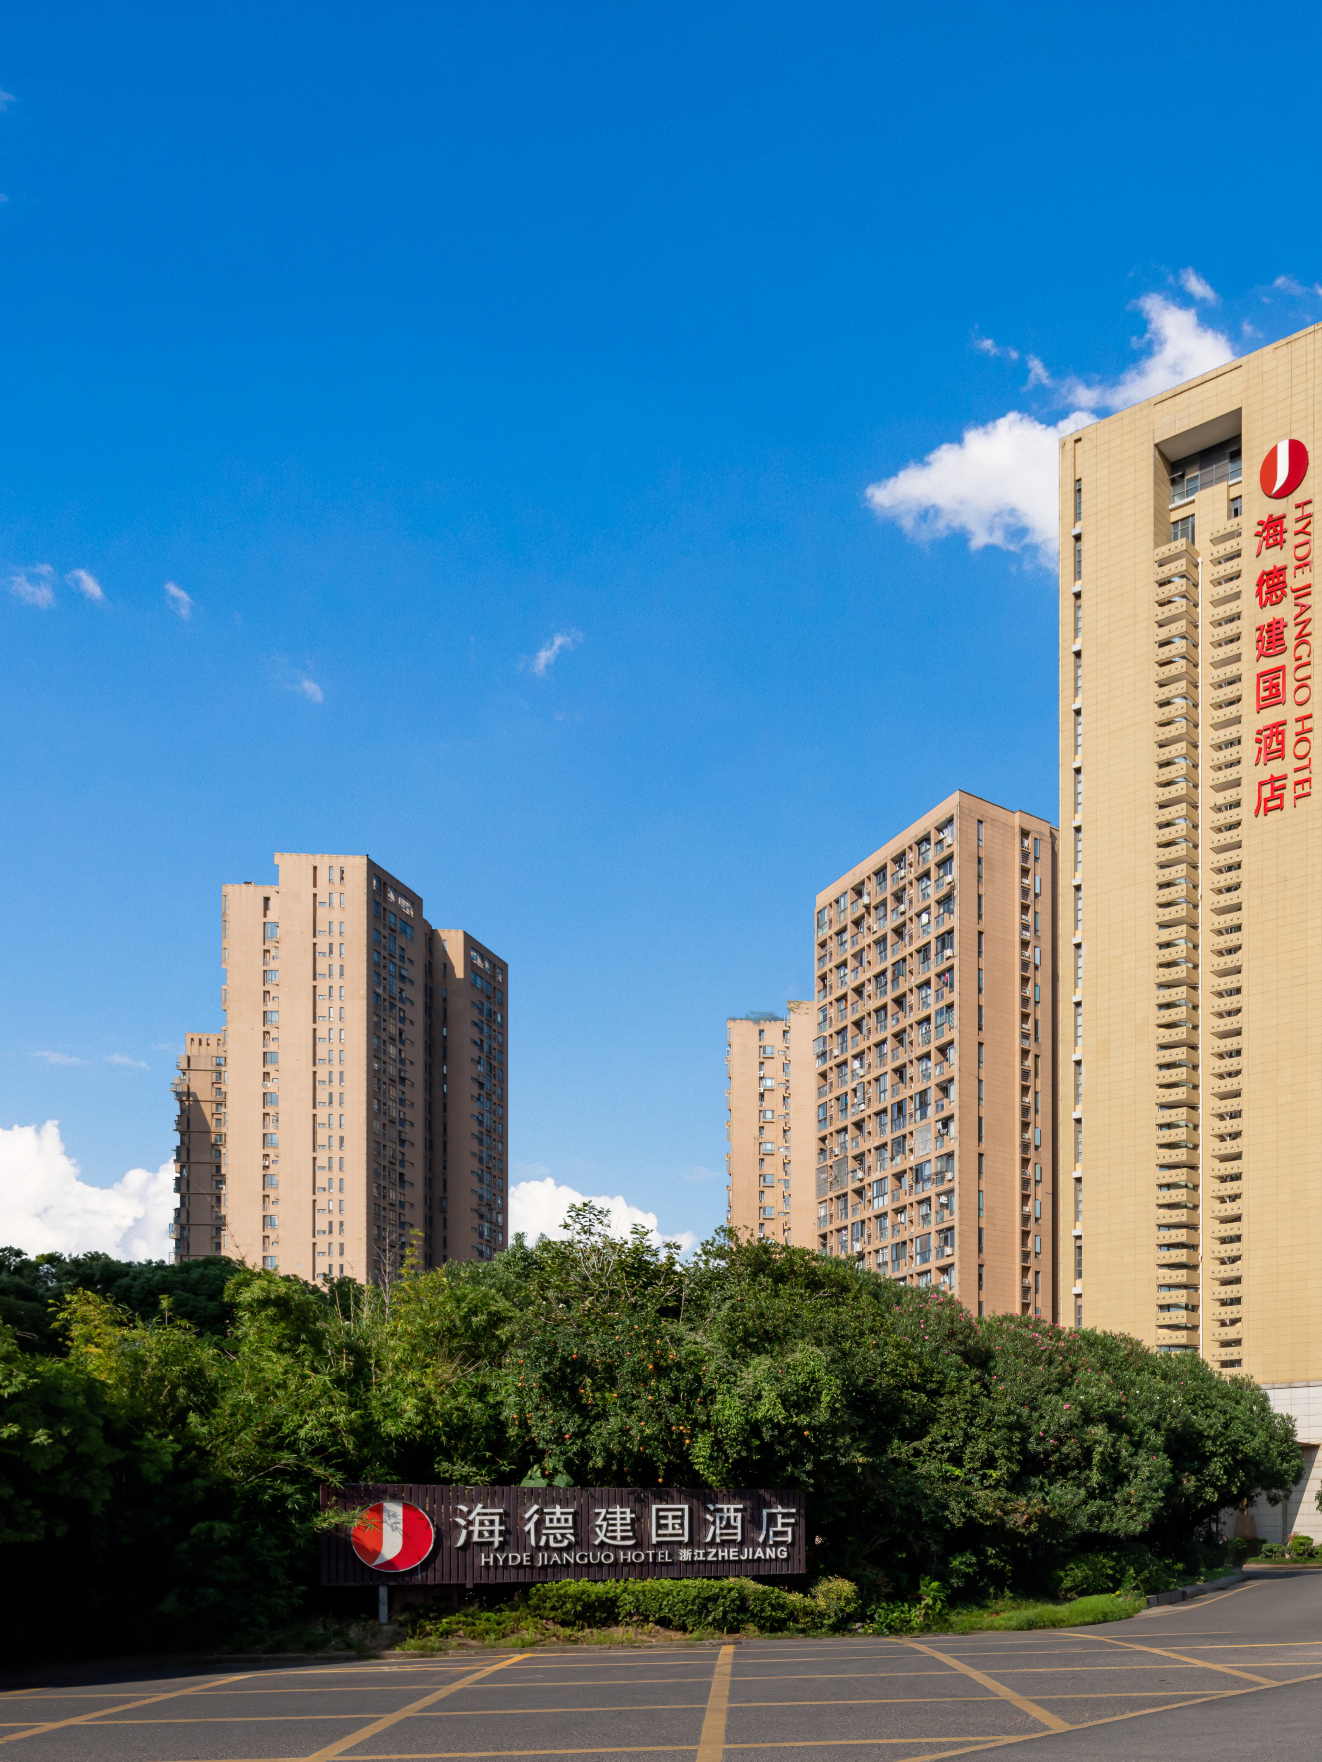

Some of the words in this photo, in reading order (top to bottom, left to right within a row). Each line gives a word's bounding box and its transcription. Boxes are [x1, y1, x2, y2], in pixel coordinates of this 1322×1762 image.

[1293, 497, 1313, 578] HYDE
[1254, 513, 1288, 818] 海德建国酒店
[1291, 584, 1313, 706] JIANGUO
[1293, 711, 1313, 808] HOTEL
[454, 1503, 797, 1549] 海德建国酒店
[480, 1552, 531, 1567] HYDE
[537, 1551, 615, 1567] JIANGUO
[619, 1550, 673, 1564] HOTEL
